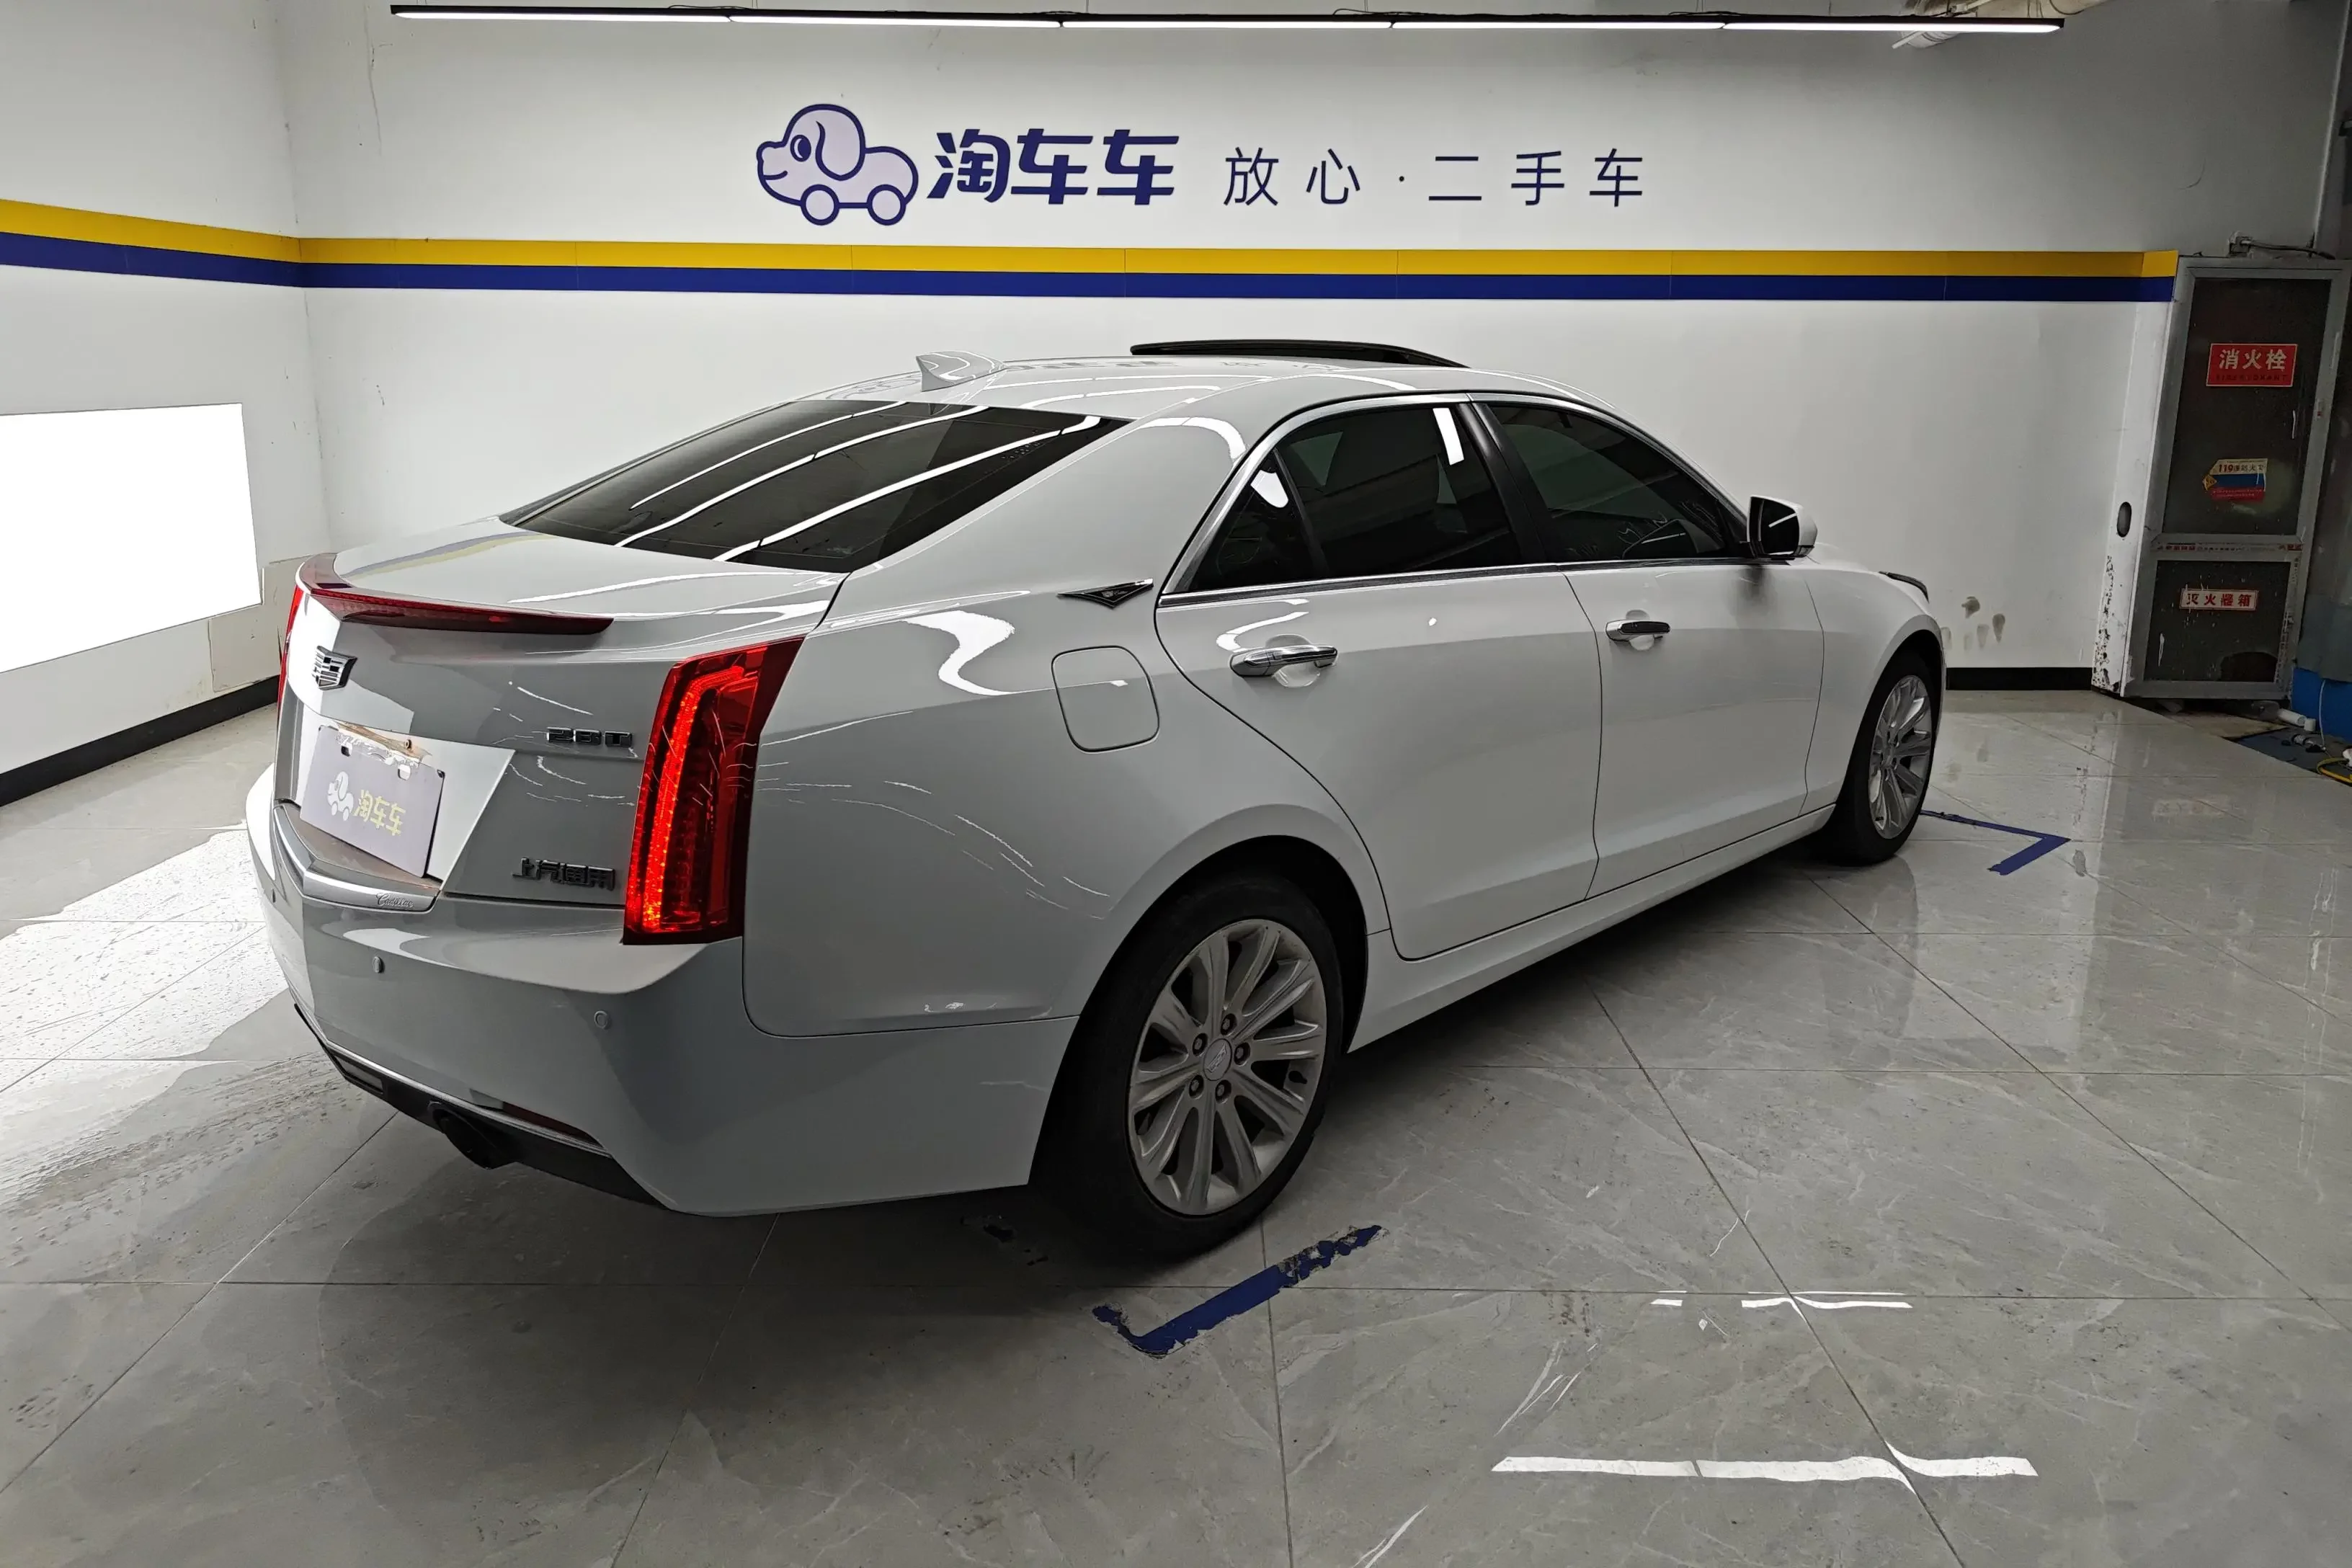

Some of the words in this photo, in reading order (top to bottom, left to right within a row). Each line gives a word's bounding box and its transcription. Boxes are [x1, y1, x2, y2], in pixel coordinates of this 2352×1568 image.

[926, 128, 1180, 205] 淘车车
[1223, 146, 1643, 207] 放心·二手车
[2219, 348, 2287, 370] 消火栓
[2186, 593, 2252, 607] 灭火器箱
[352, 789, 406, 836] 淘车车
[375, 892, 414, 909] Cadillac
